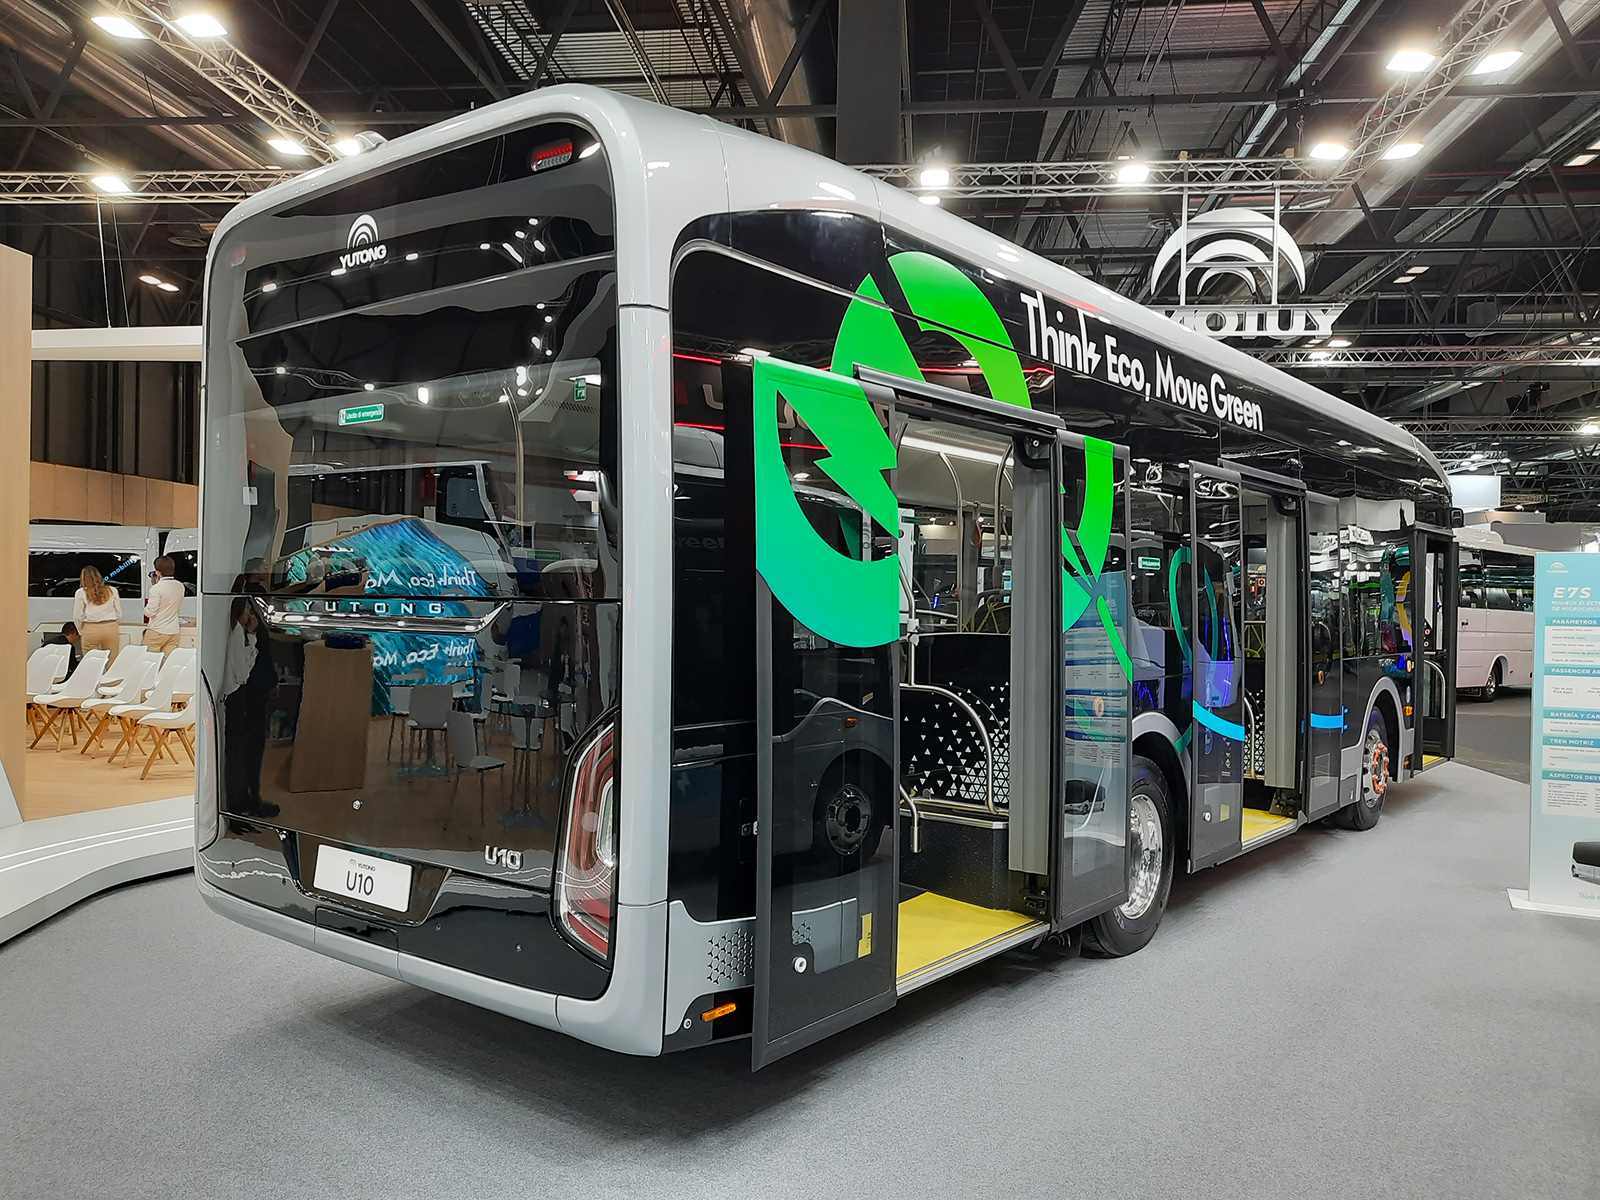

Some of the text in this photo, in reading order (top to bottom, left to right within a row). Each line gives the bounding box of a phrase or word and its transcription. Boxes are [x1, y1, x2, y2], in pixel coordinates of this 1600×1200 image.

[339, 244, 387, 269] YUTONG
[1020, 290, 1264, 432] Think Eco, Move Green
[1553, 586, 1591, 599] E7S
[303, 601, 445, 615] YUTONG
[1551, 667, 1591, 675] PASSENGER
[1549, 772, 1583, 780] ASPECTOS
[484, 844, 524, 870] U10
[346, 870, 374, 896] U10
